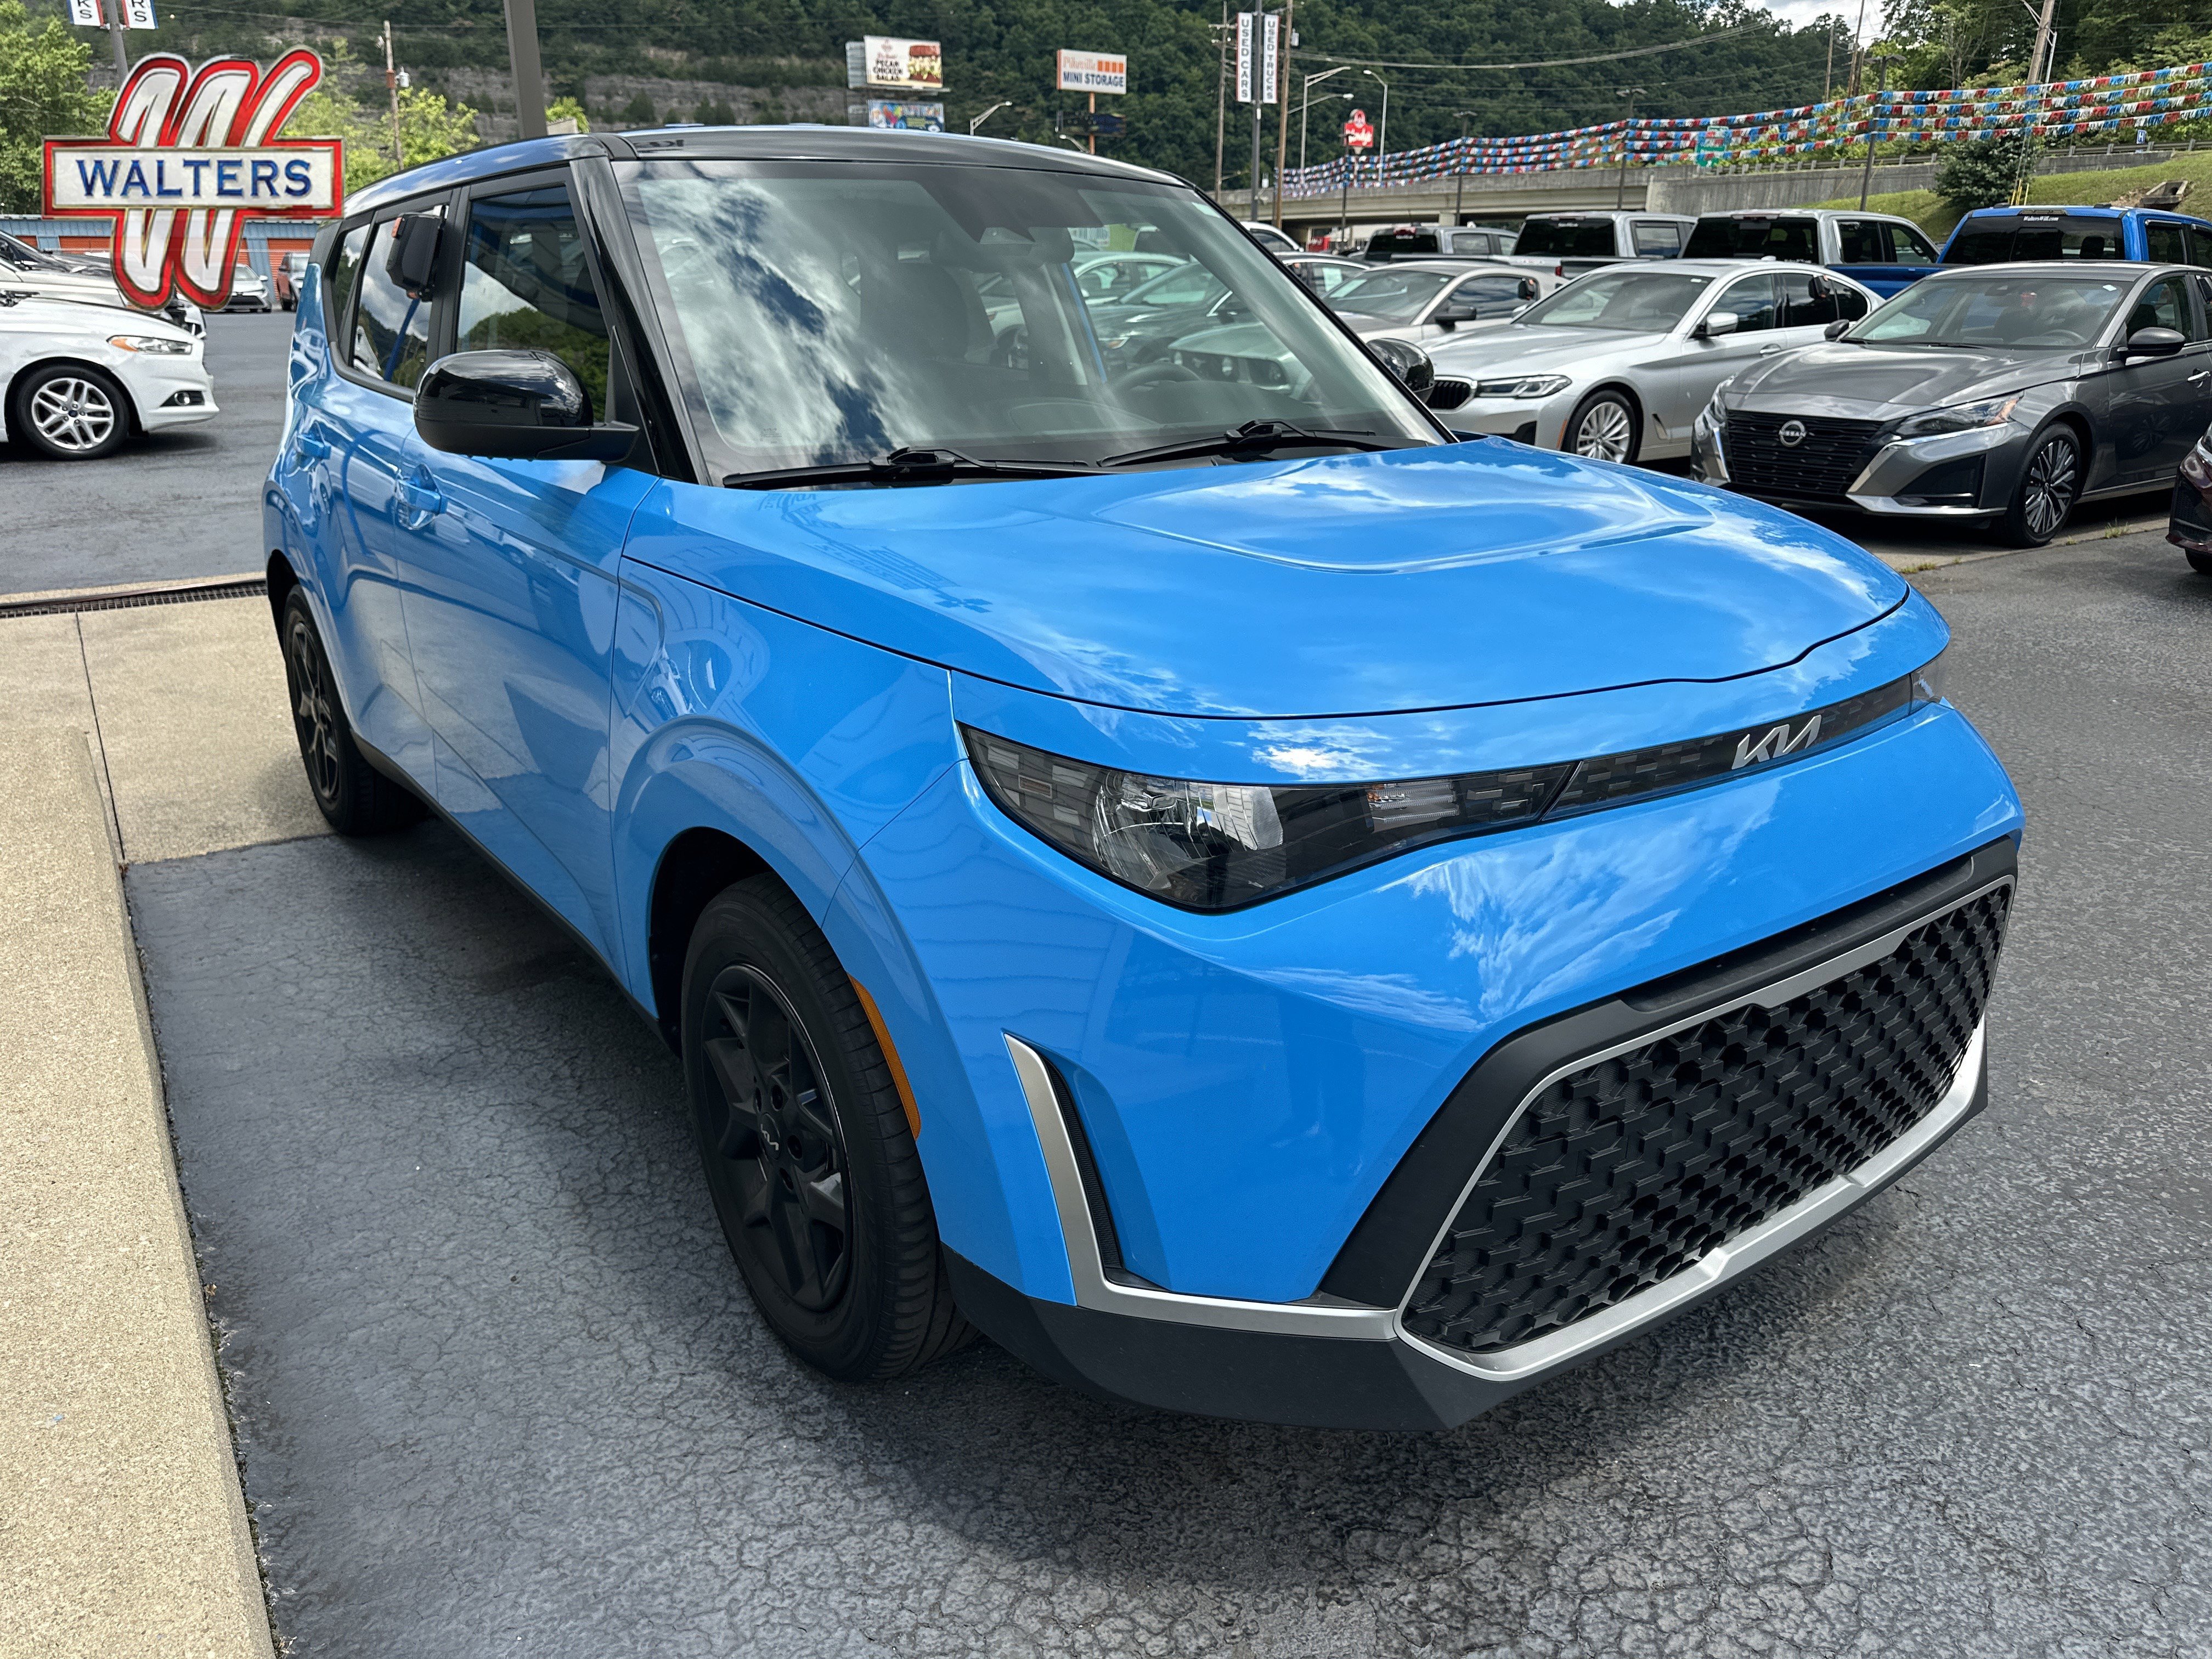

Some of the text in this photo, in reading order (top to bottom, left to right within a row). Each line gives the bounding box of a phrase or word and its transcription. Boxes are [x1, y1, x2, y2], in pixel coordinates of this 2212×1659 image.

[1063, 71, 1124, 87] MINI STORAGE
[1240, 19, 1249, 99] USED CARS
[1266, 20, 1276, 100] USED TRUCKS
